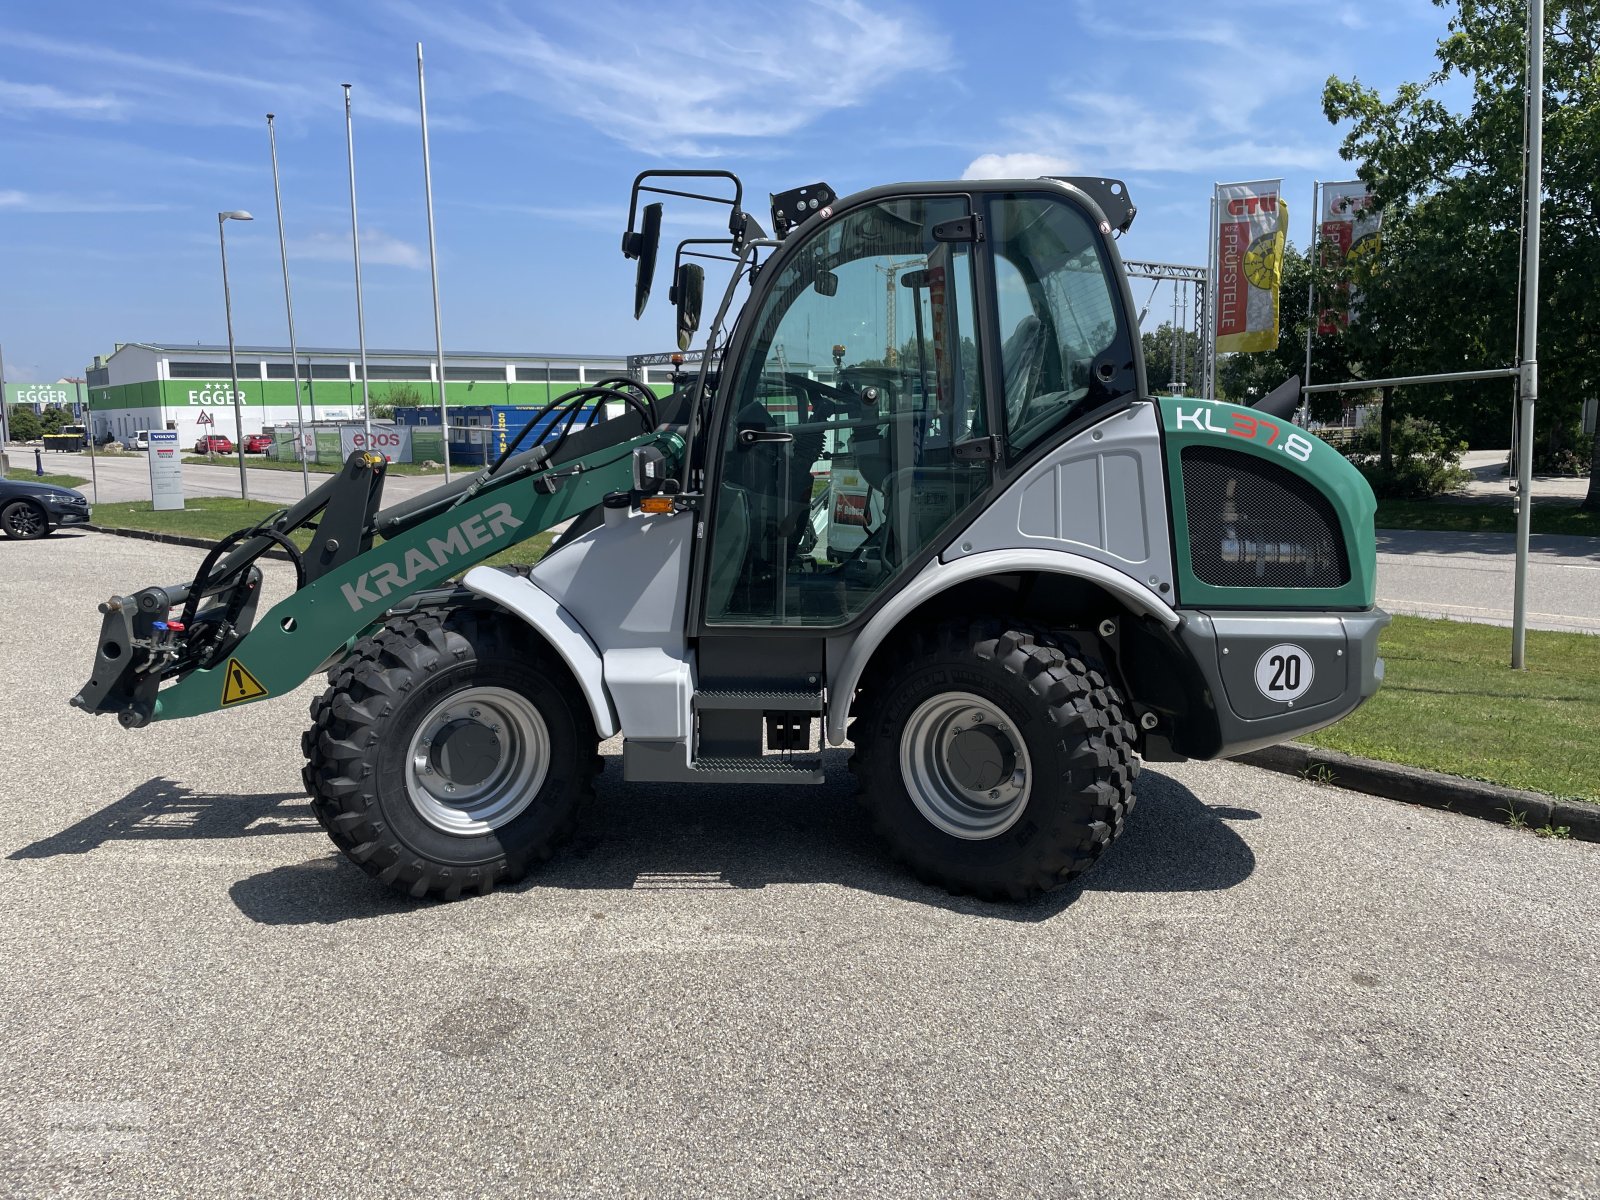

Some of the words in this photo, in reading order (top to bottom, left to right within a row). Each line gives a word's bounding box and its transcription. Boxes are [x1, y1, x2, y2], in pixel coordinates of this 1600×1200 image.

[1224, 225, 1240, 233] KFZ
[1222, 235, 1240, 328] PRÜFSTELLE
[17, 390, 68, 403] EGGER
[188, 390, 247, 405] EGGER
[843, 505, 866, 516] Bobca
[340, 502, 524, 612] KRAMER
[1269, 655, 1301, 691] 20
